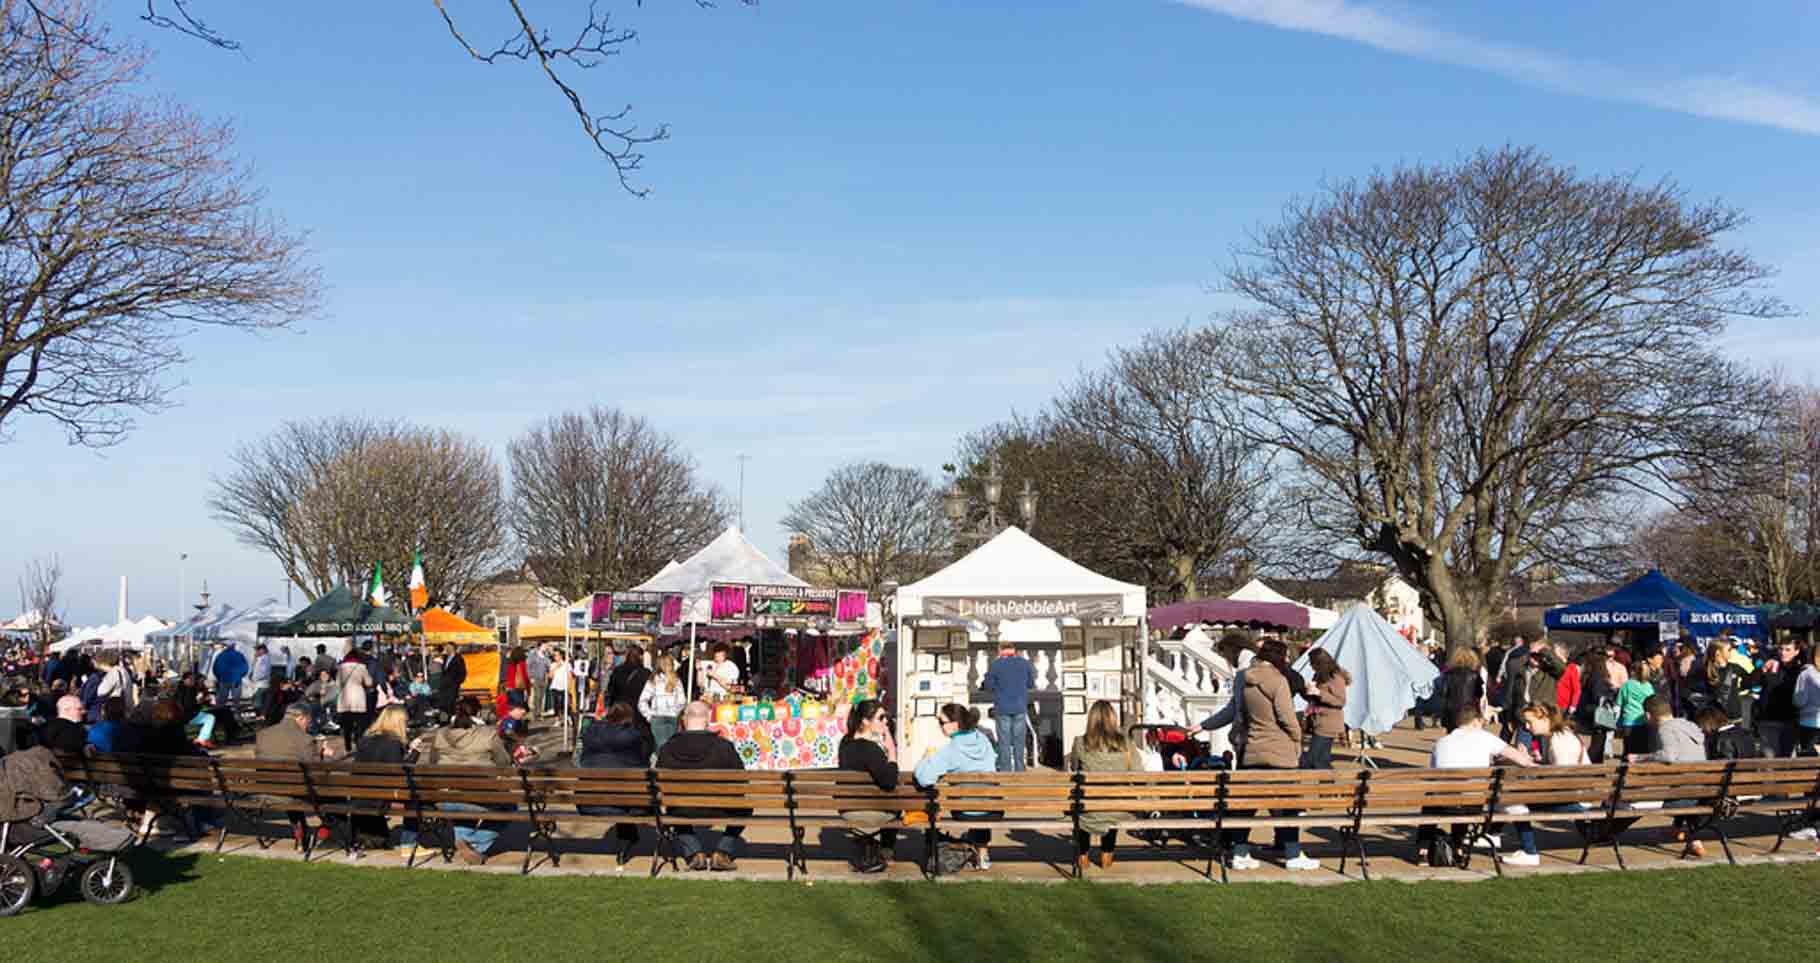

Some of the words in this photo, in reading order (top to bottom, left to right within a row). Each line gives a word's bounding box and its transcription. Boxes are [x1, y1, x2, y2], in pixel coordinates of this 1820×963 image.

[975, 599, 1078, 617] IrishPebbleArt
[1560, 611, 1610, 624] BRYAN'S
[1690, 612, 1725, 624] BRYAN'S
[1725, 613, 1758, 625] COFFEE
